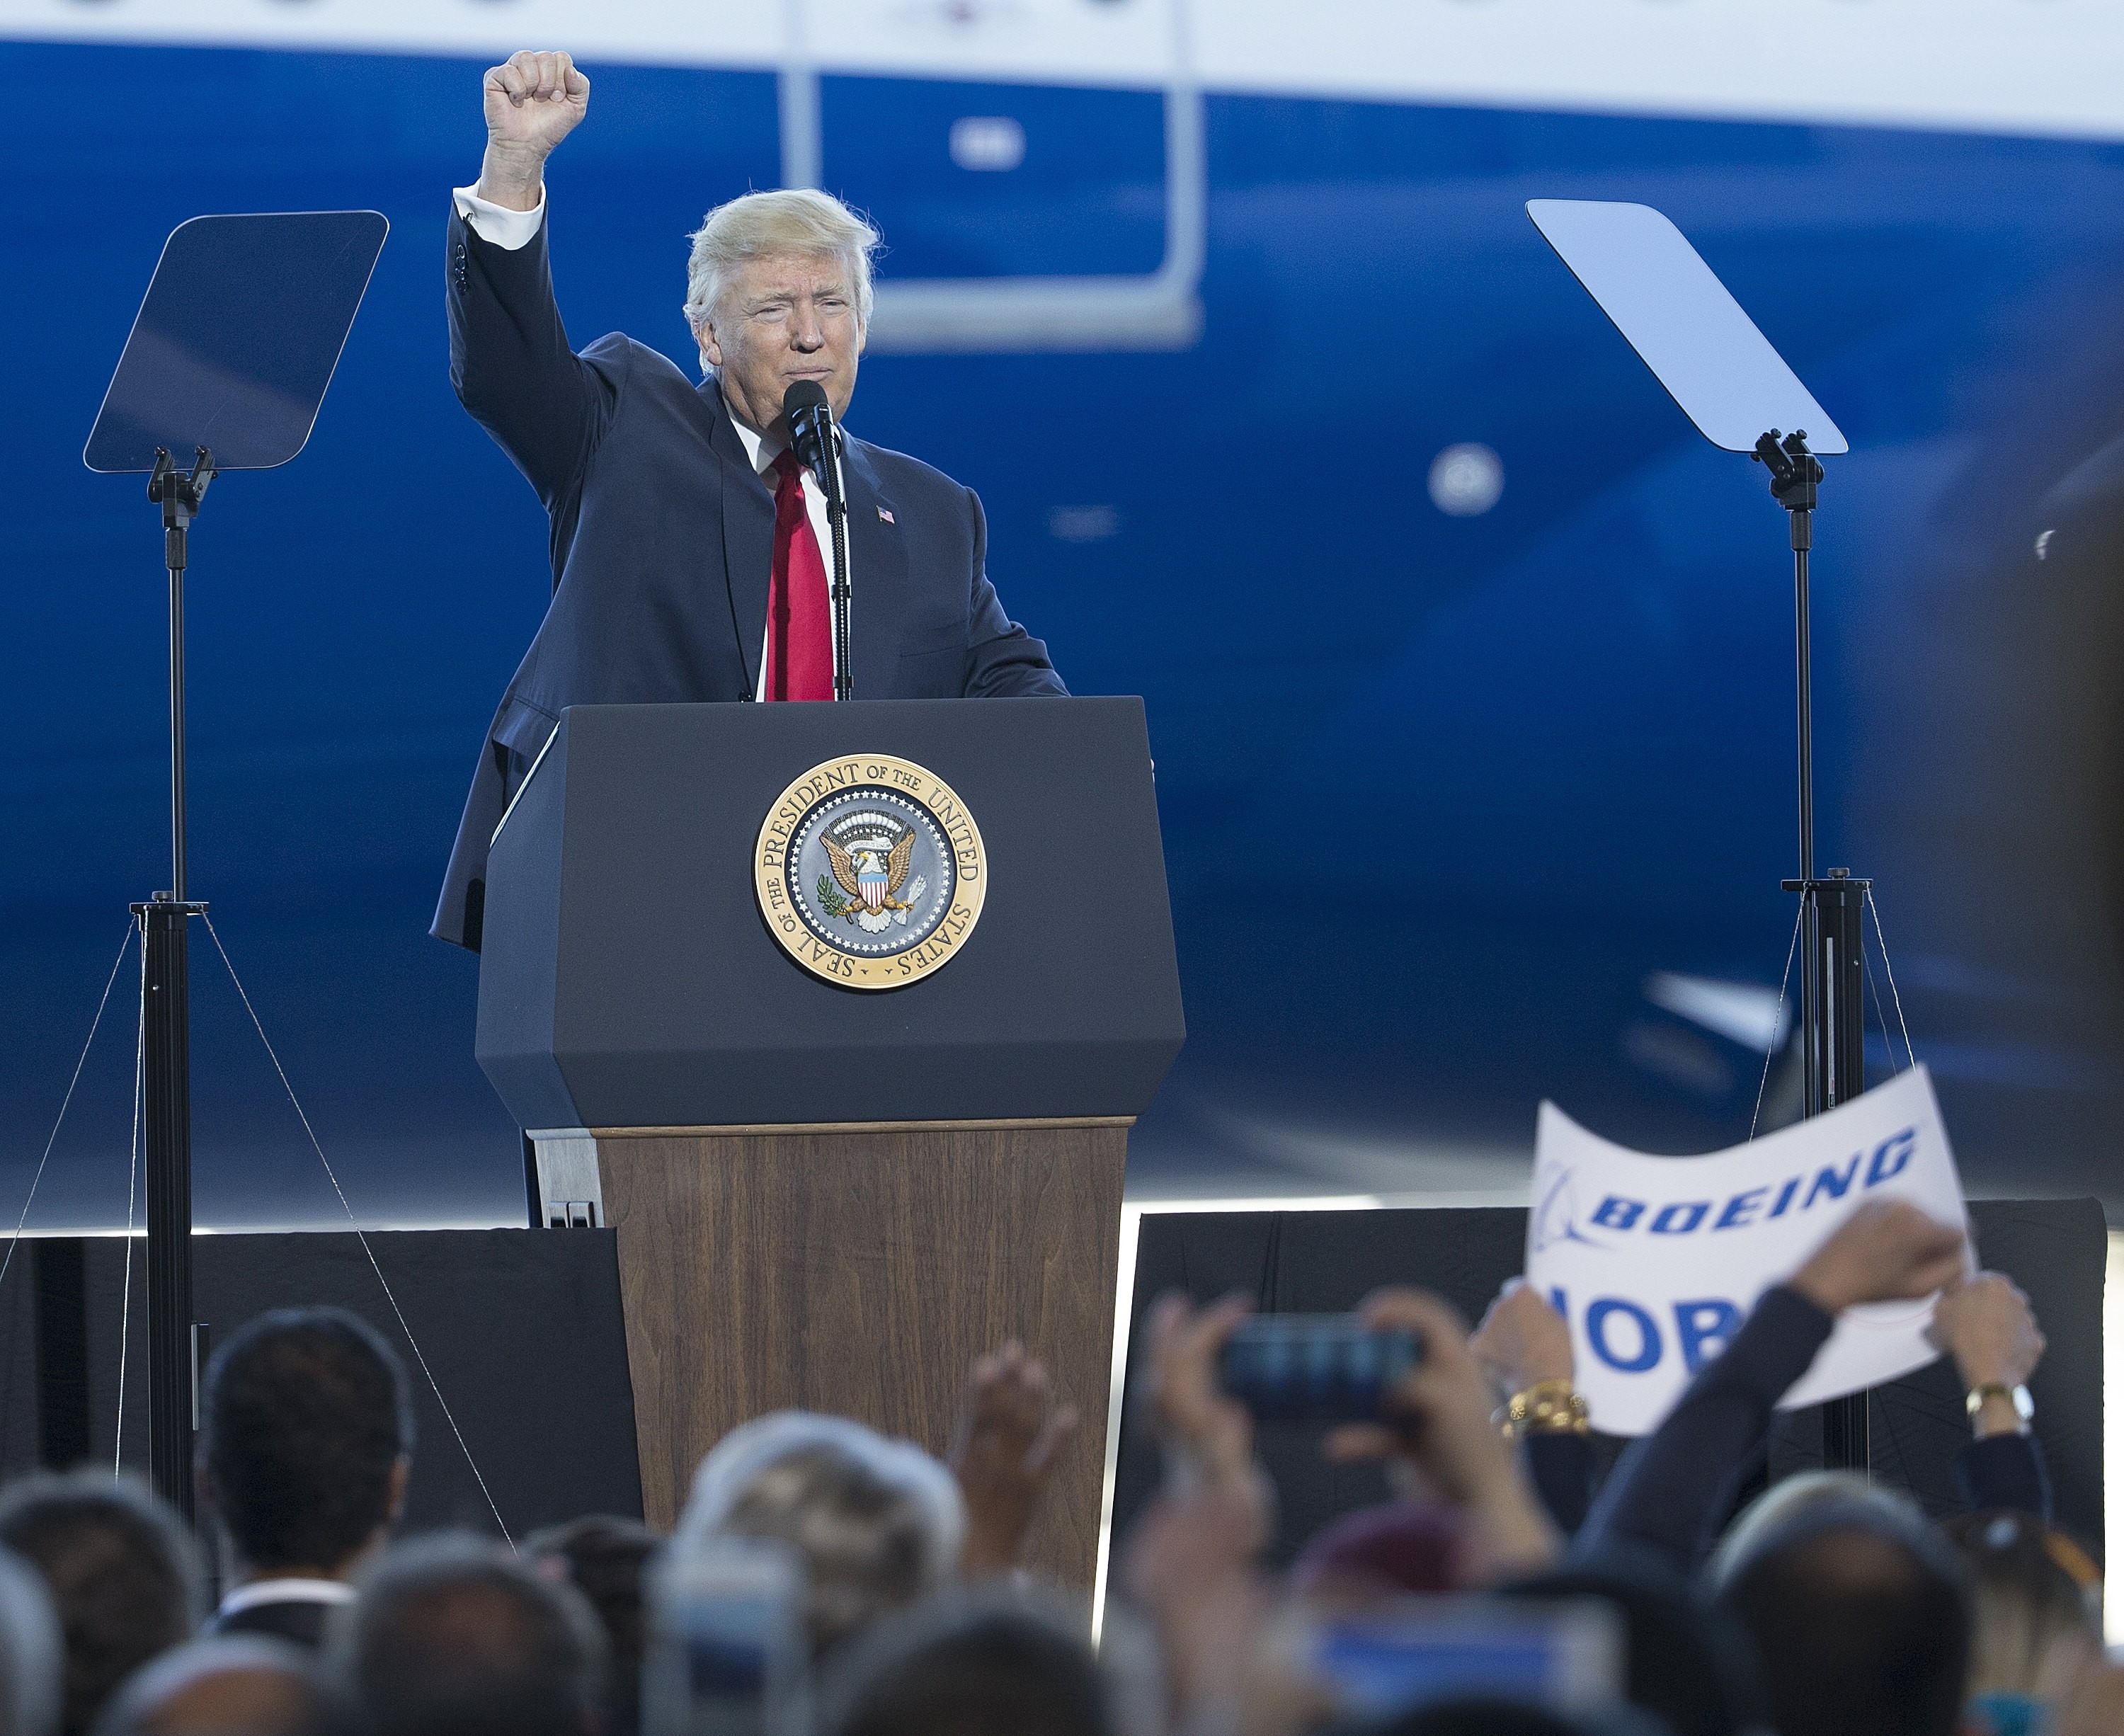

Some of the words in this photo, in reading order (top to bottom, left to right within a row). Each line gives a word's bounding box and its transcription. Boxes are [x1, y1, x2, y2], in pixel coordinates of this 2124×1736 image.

[866, 765, 889, 780] OF
[893, 769, 923, 791] THE
[763, 763, 860, 868] PRESIDENT
[927, 787, 978, 881] UNITED
[767, 877, 787, 910] THE
[778, 912, 797, 933] OF
[800, 929, 856, 978] SEAL
[897, 903, 971, 976] STATES
[1590, 1127, 1916, 1235] BOEING
[1548, 1285, 1742, 1375] OB
